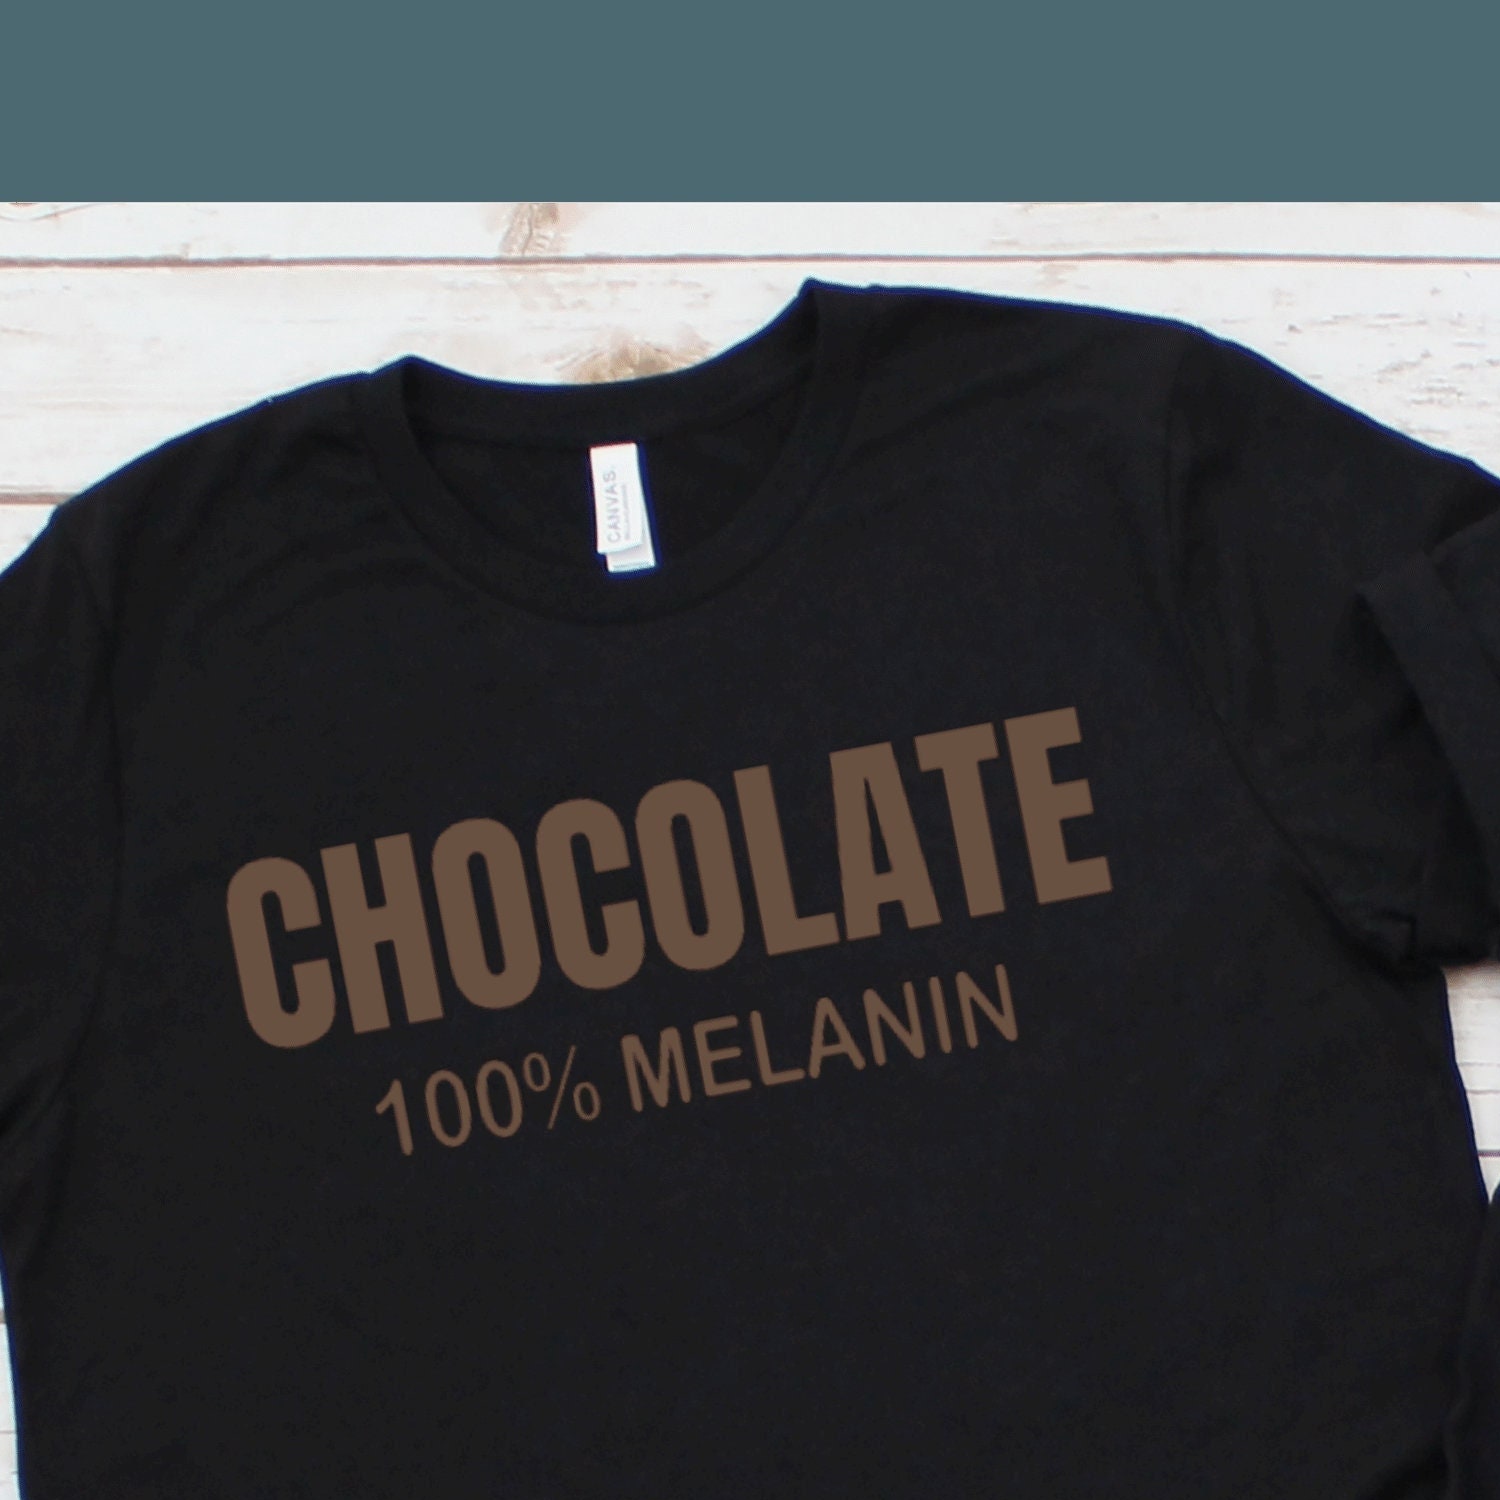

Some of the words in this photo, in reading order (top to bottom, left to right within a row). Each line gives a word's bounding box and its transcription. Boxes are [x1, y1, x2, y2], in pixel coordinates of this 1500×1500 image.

[226, 706, 1113, 1049] CHOCOLATE
[375, 1046, 601, 1156] 100%
[620, 963, 1019, 1112] MELANIN
